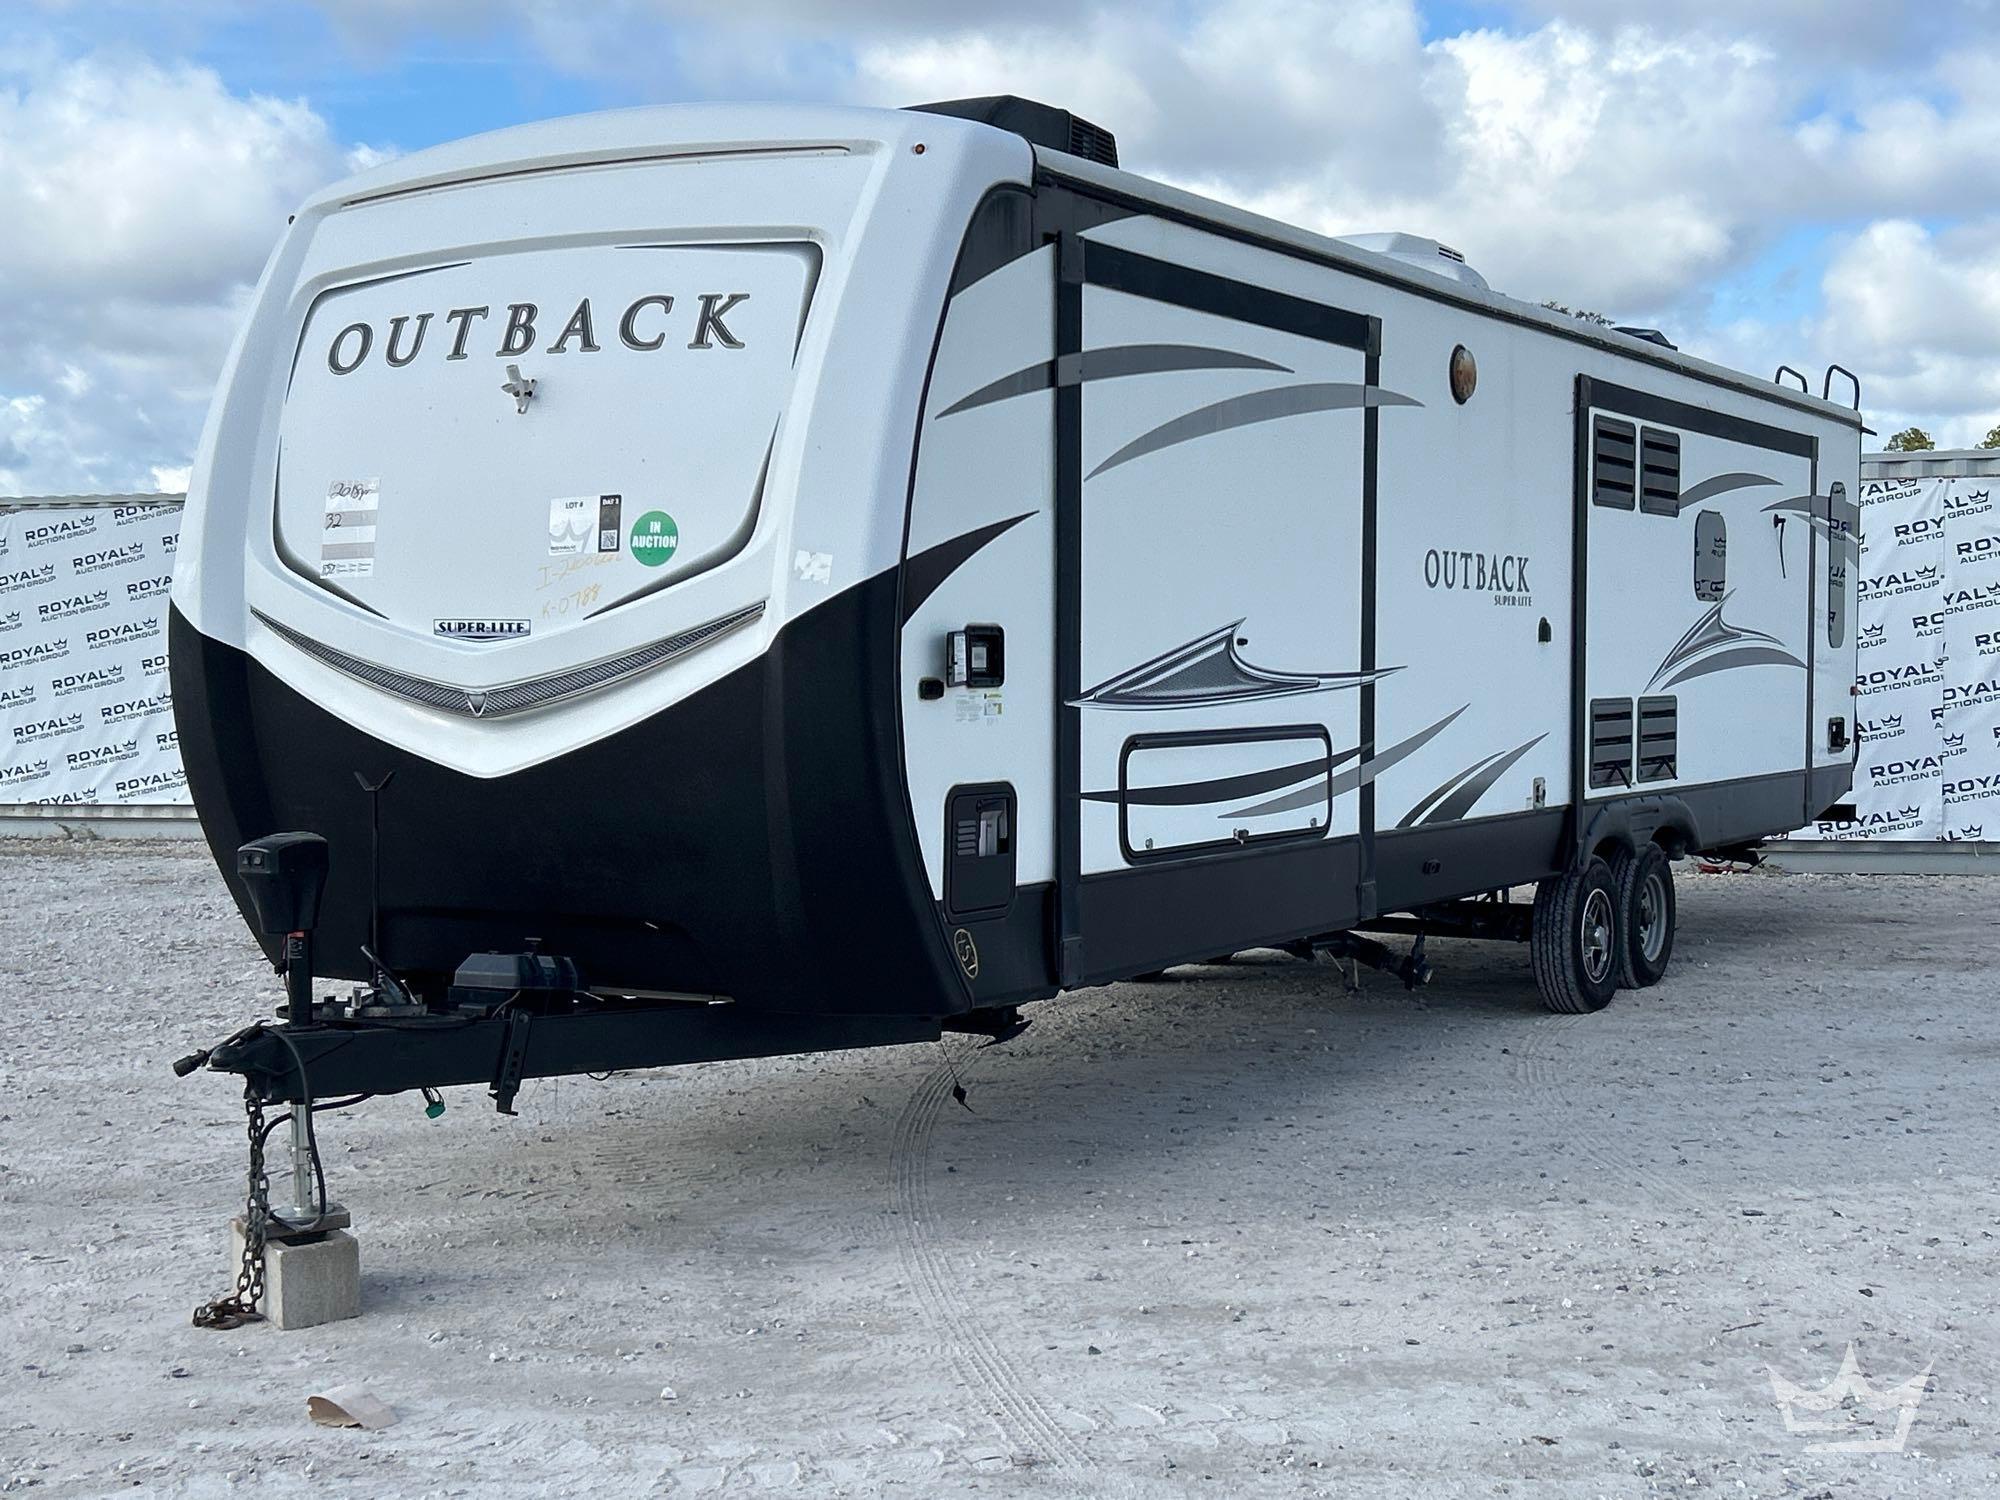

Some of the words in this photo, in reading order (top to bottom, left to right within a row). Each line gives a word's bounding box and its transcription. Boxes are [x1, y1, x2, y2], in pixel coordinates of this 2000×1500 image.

[327, 293, 750, 376] OUTBACK
[565, 501, 578, 509] LOT
[1877, 488, 1922, 502] GROUP
[116, 513, 155, 527] AUCTION
[1947, 504, 1993, 519] GROUP
[25, 520, 81, 541] ROYAL
[649, 521, 661, 533] IN
[1894, 515, 1945, 537] ROY
[28, 534, 65, 548] AUCTION
[67, 526, 97, 539] GROUP
[632, 535, 677, 548] AUCTION
[1897, 531, 1945, 546] AUCTIO
[73, 547, 129, 568] ROYAL
[75, 562, 114, 576] AUCTION
[115, 553, 146, 566] GROUP
[1960, 550, 2000, 564] AUCTI
[0, 569, 40, 586] OYAL
[1424, 548, 1530, 592] OUTBACK
[27, 575, 56, 587] GROUP
[127, 575, 173, 594] ROYA
[1895, 579, 1940, 595] GROUP
[38, 594, 94, 615] ROYAL
[1943, 588, 1987, 605] YAL
[41, 608, 79, 623] AUCTION
[80, 601, 111, 613] GROUP
[86, 622, 143, 643] ROYAL
[88, 636, 128, 650] AUCTION
[129, 629, 161, 641] GROUP
[0, 643, 54, 664] ROYAL
[2, 657, 40, 671] AUCTION
[41, 650, 70, 661] GROUP
[52, 669, 108, 690] ROYAL
[1856, 663, 1934, 687] ROYAL
[54, 683, 93, 697] AUCTION
[94, 676, 126, 689] GROUP
[7, 696, 36, 709] GROUP
[101, 697, 157, 717] ROYAL
[1943, 697, 1982, 710] CTION
[13, 717, 69, 737] ROYAL
[103, 711, 143, 725] AUCTION
[16, 732, 54, 745] AUCTION
[55, 724, 85, 737] GROUP
[1860, 729, 1905, 743] GROUP
[66, 743, 123, 764] ROYAL
[69, 758, 108, 771] AUCTION
[109, 751, 140, 763] GROUP
[20, 770, 51, 783] GROUP
[1870, 754, 1943, 779] ROYA
[115, 772, 172, 792] ROYAL
[1872, 771, 1930, 788] AUCTION
[118, 786, 157, 800] AUCTION
[1817, 811, 1900, 835] ROYAL
[1879, 819, 1924, 834] GROUP
